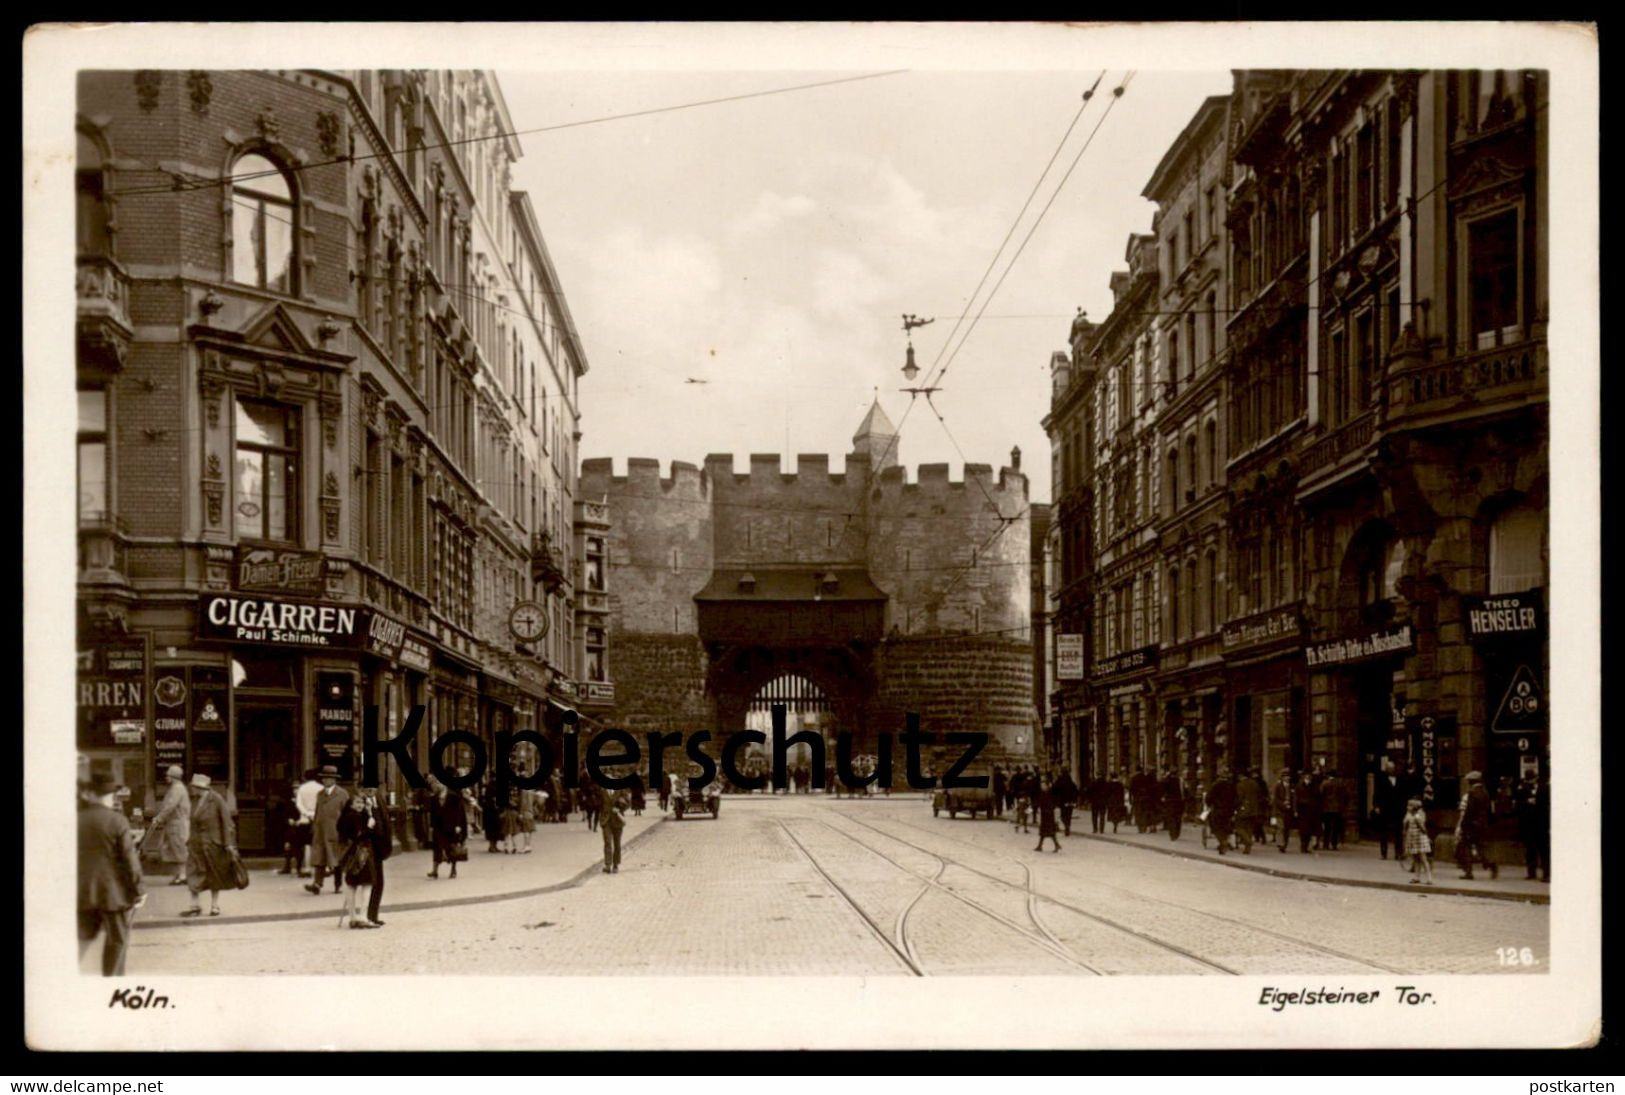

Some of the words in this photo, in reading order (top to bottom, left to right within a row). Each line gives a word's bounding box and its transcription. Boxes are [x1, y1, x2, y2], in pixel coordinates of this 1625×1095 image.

[240, 562, 280, 586] Damen
[208, 597, 356, 635] CIGARREN
[1482, 599, 1520, 609] THEO
[1470, 607, 1537, 634] HENSELER
[236, 626, 267, 642] Paul
[271, 629, 331, 646] Schimke.
